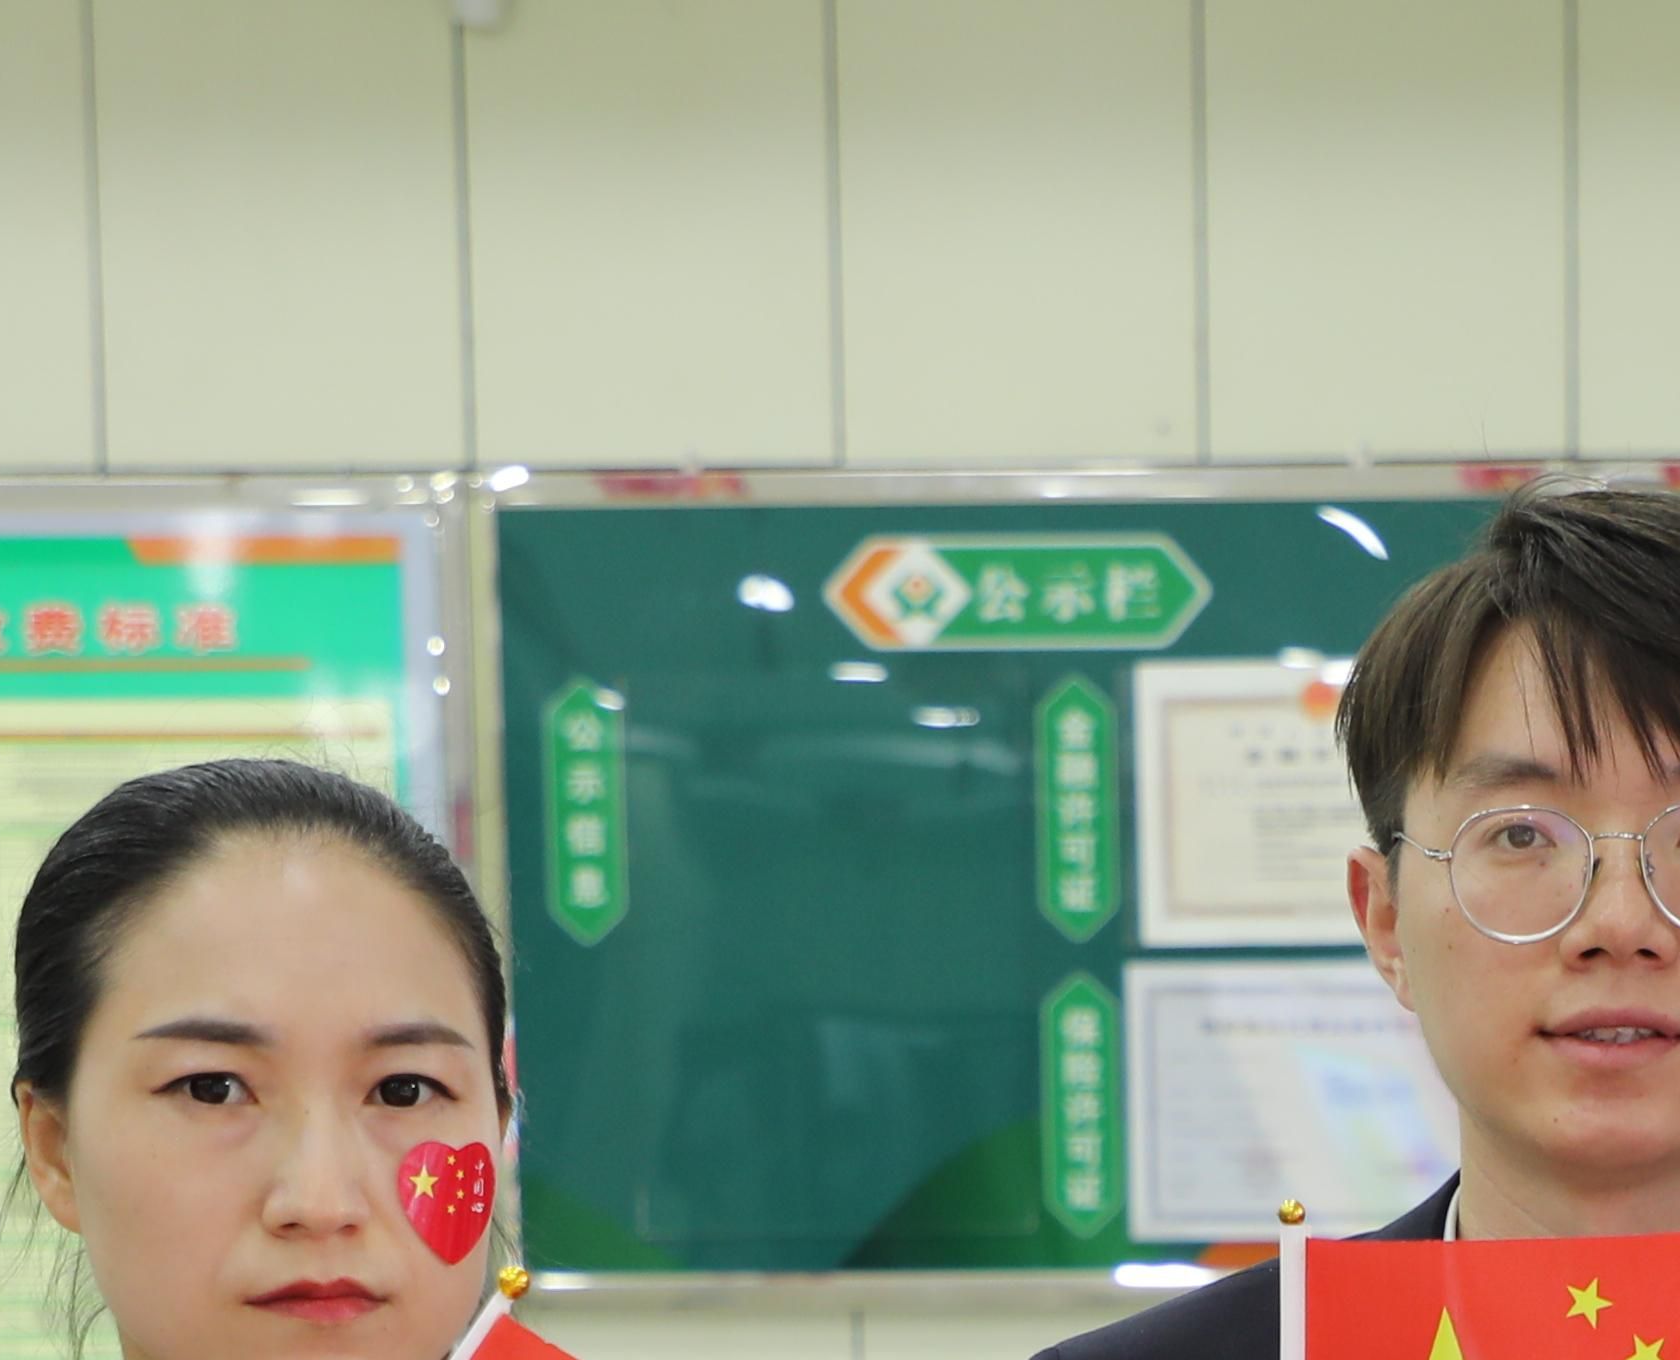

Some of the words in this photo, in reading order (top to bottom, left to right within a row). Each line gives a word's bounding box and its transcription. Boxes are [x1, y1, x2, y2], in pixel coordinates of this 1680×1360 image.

[976, 561, 1162, 623] 公示栏
[562, 707, 610, 909] 公示信息
